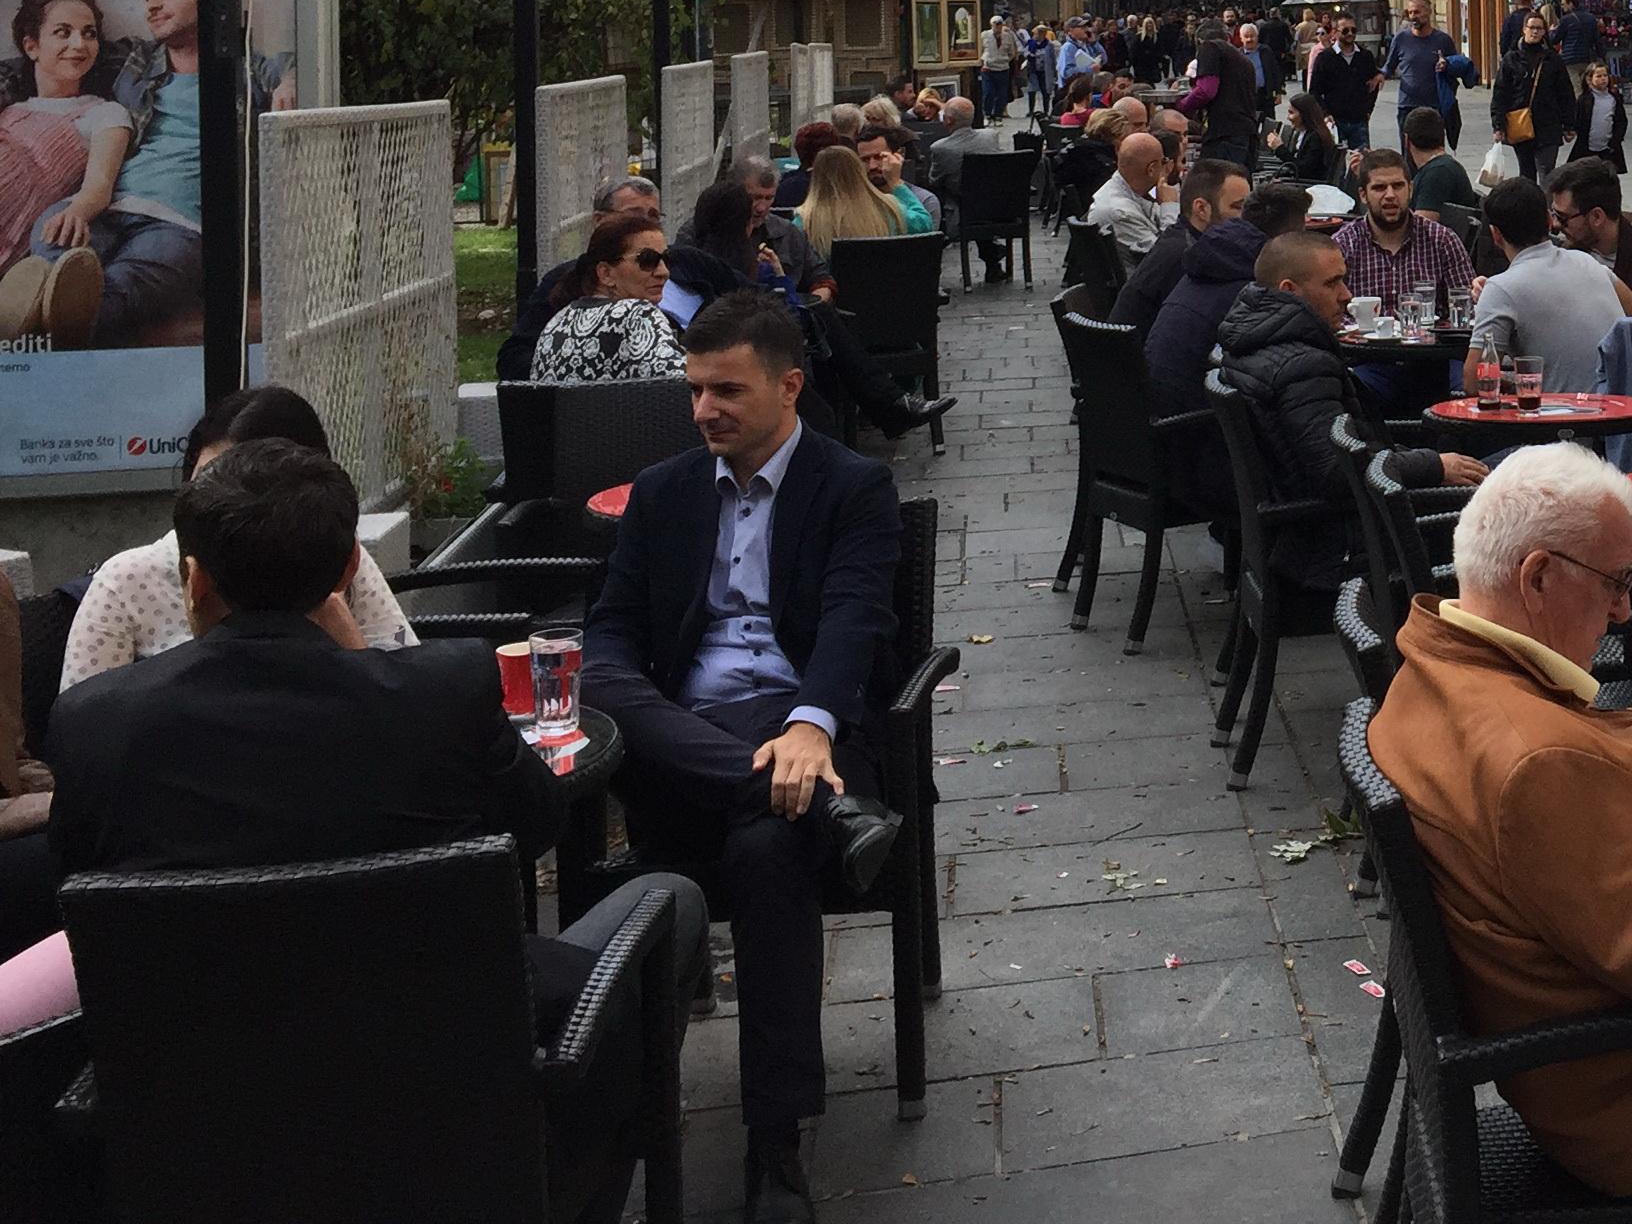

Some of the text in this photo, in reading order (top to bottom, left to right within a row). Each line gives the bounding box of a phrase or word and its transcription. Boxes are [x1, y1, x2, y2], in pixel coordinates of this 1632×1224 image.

[20, 439, 55, 451] Banka
[58, 440, 72, 449] za
[75, 439, 94, 449] sve
[21, 454, 47, 465] vam
